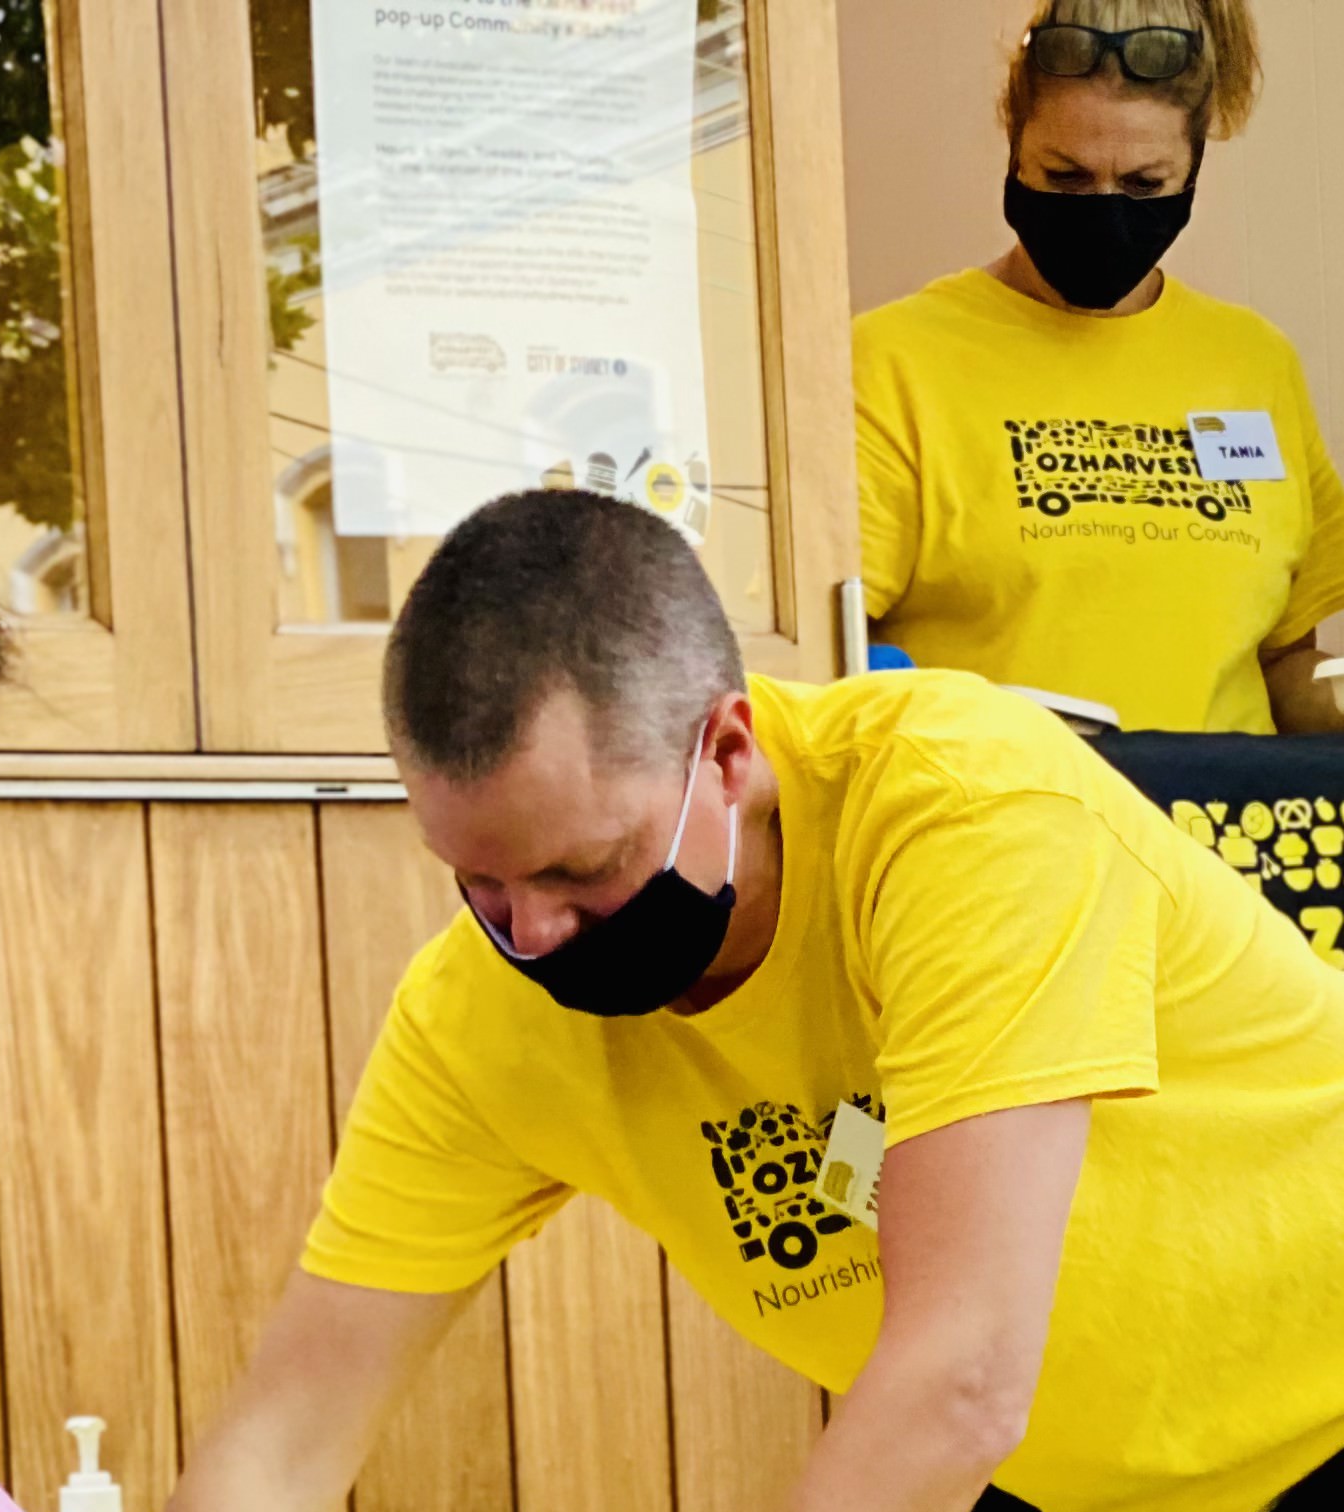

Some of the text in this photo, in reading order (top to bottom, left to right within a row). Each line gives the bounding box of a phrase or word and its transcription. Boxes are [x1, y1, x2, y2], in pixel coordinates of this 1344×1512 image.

[374, 8, 445, 31] pop-up
[1217, 445, 1265, 460] TANIA
[1019, 518, 1262, 554] Nourishing Our Country
[752, 1254, 881, 1318] Nourishi
